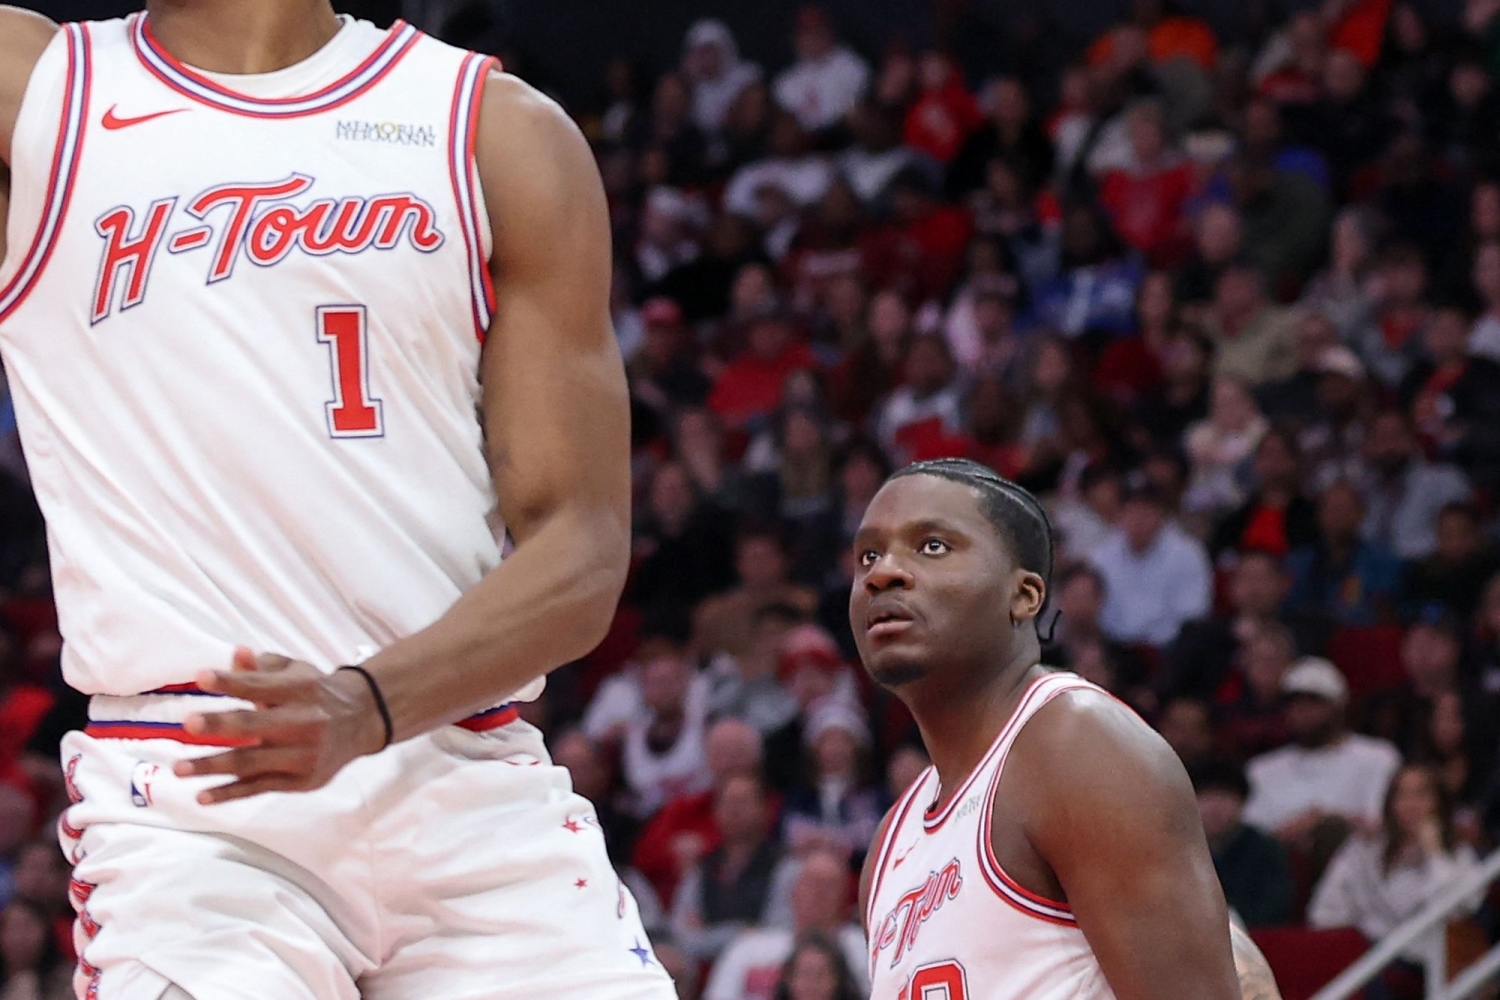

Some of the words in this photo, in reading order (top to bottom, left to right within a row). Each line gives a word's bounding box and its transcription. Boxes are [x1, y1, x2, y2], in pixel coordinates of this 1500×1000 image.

[336, 119, 436, 139] MEMORIAL
[90, 172, 445, 326] H-Town
[315, 304, 384, 439] 1
